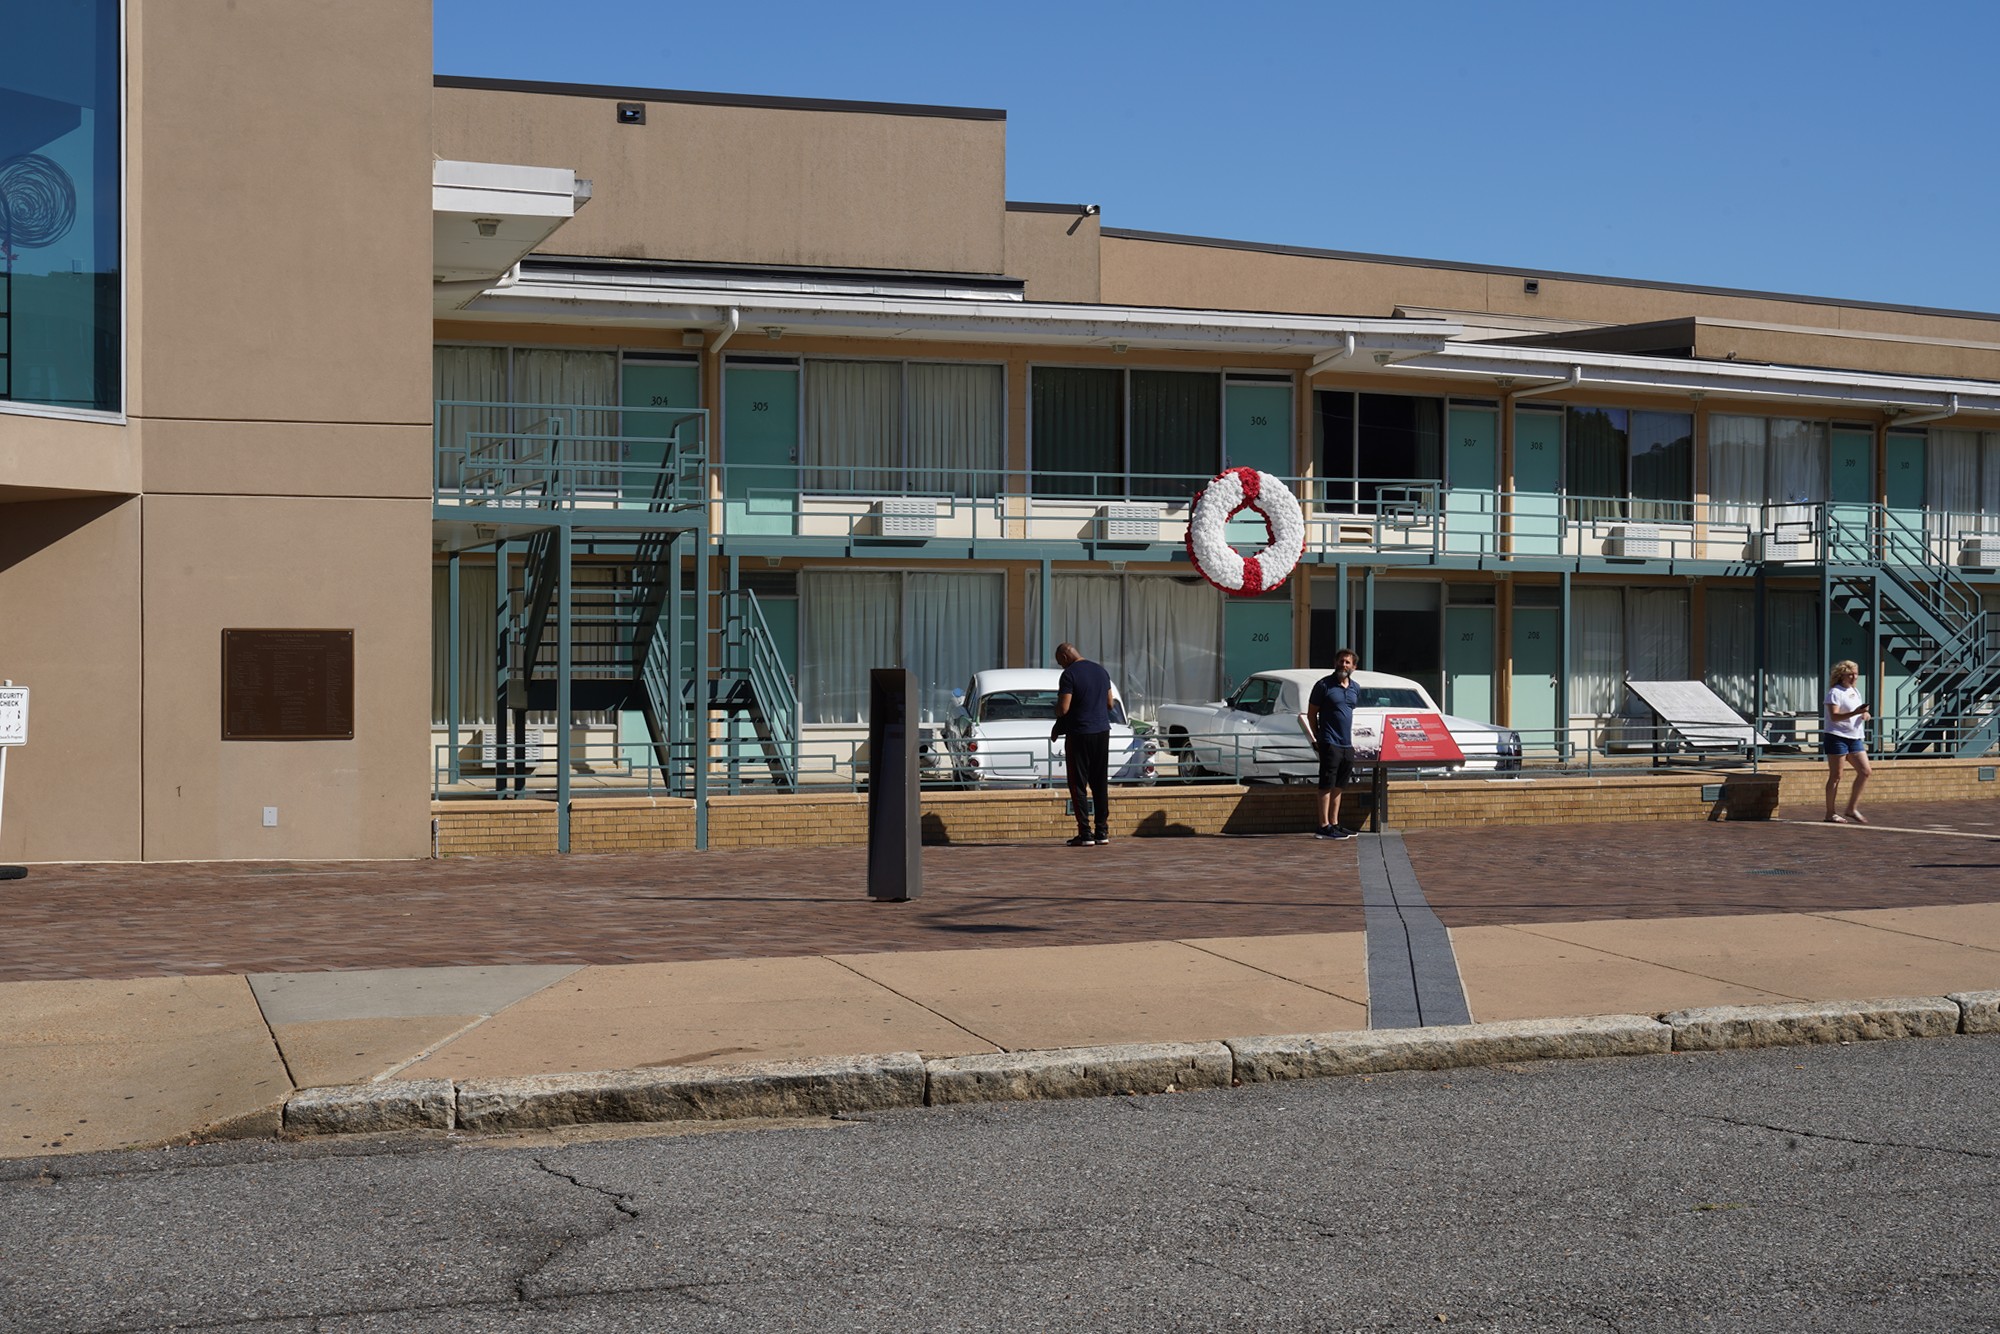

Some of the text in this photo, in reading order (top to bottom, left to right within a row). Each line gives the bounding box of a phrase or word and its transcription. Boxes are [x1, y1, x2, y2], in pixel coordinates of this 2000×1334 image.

[651, 396, 668, 406] 304
[752, 402, 769, 411] 305
[1250, 416, 1267, 426] 306
[1463, 438, 1477, 447] 307
[1530, 441, 1543, 450] 308
[1252, 632, 1270, 642] 206
[1461, 632, 1474, 641] 207
